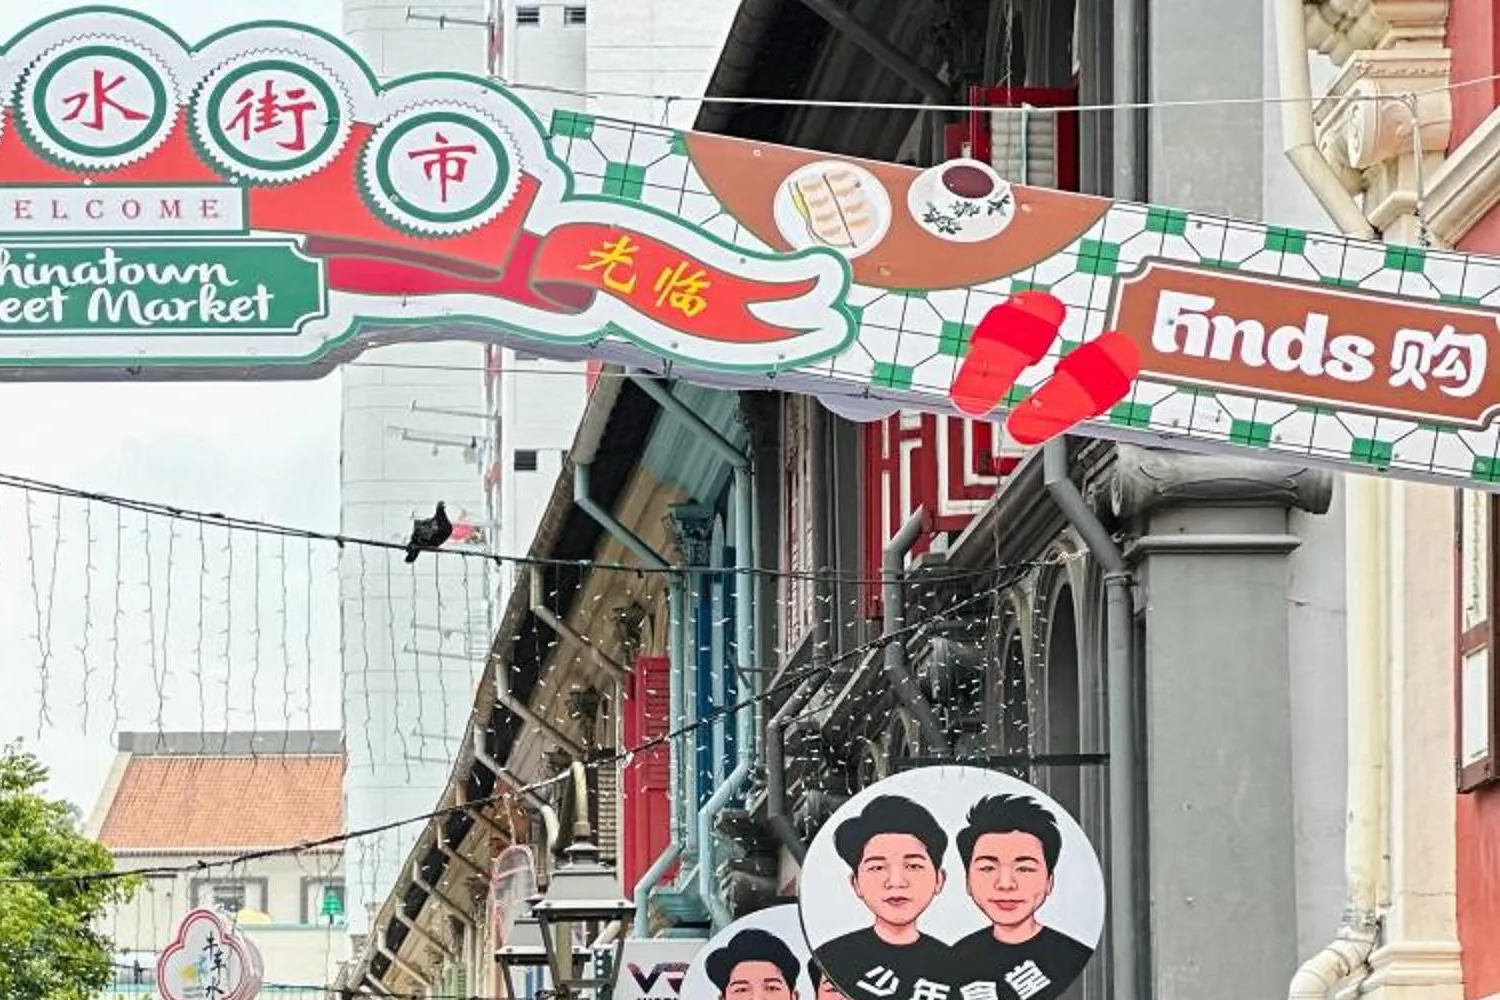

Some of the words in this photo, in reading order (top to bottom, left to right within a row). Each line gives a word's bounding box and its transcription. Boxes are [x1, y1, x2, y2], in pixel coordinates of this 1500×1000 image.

[87, 283, 275, 326] Market
[577, 235, 713, 320] 光临
[1151, 290, 1376, 383] Finds
[1388, 322, 1488, 399] 购
